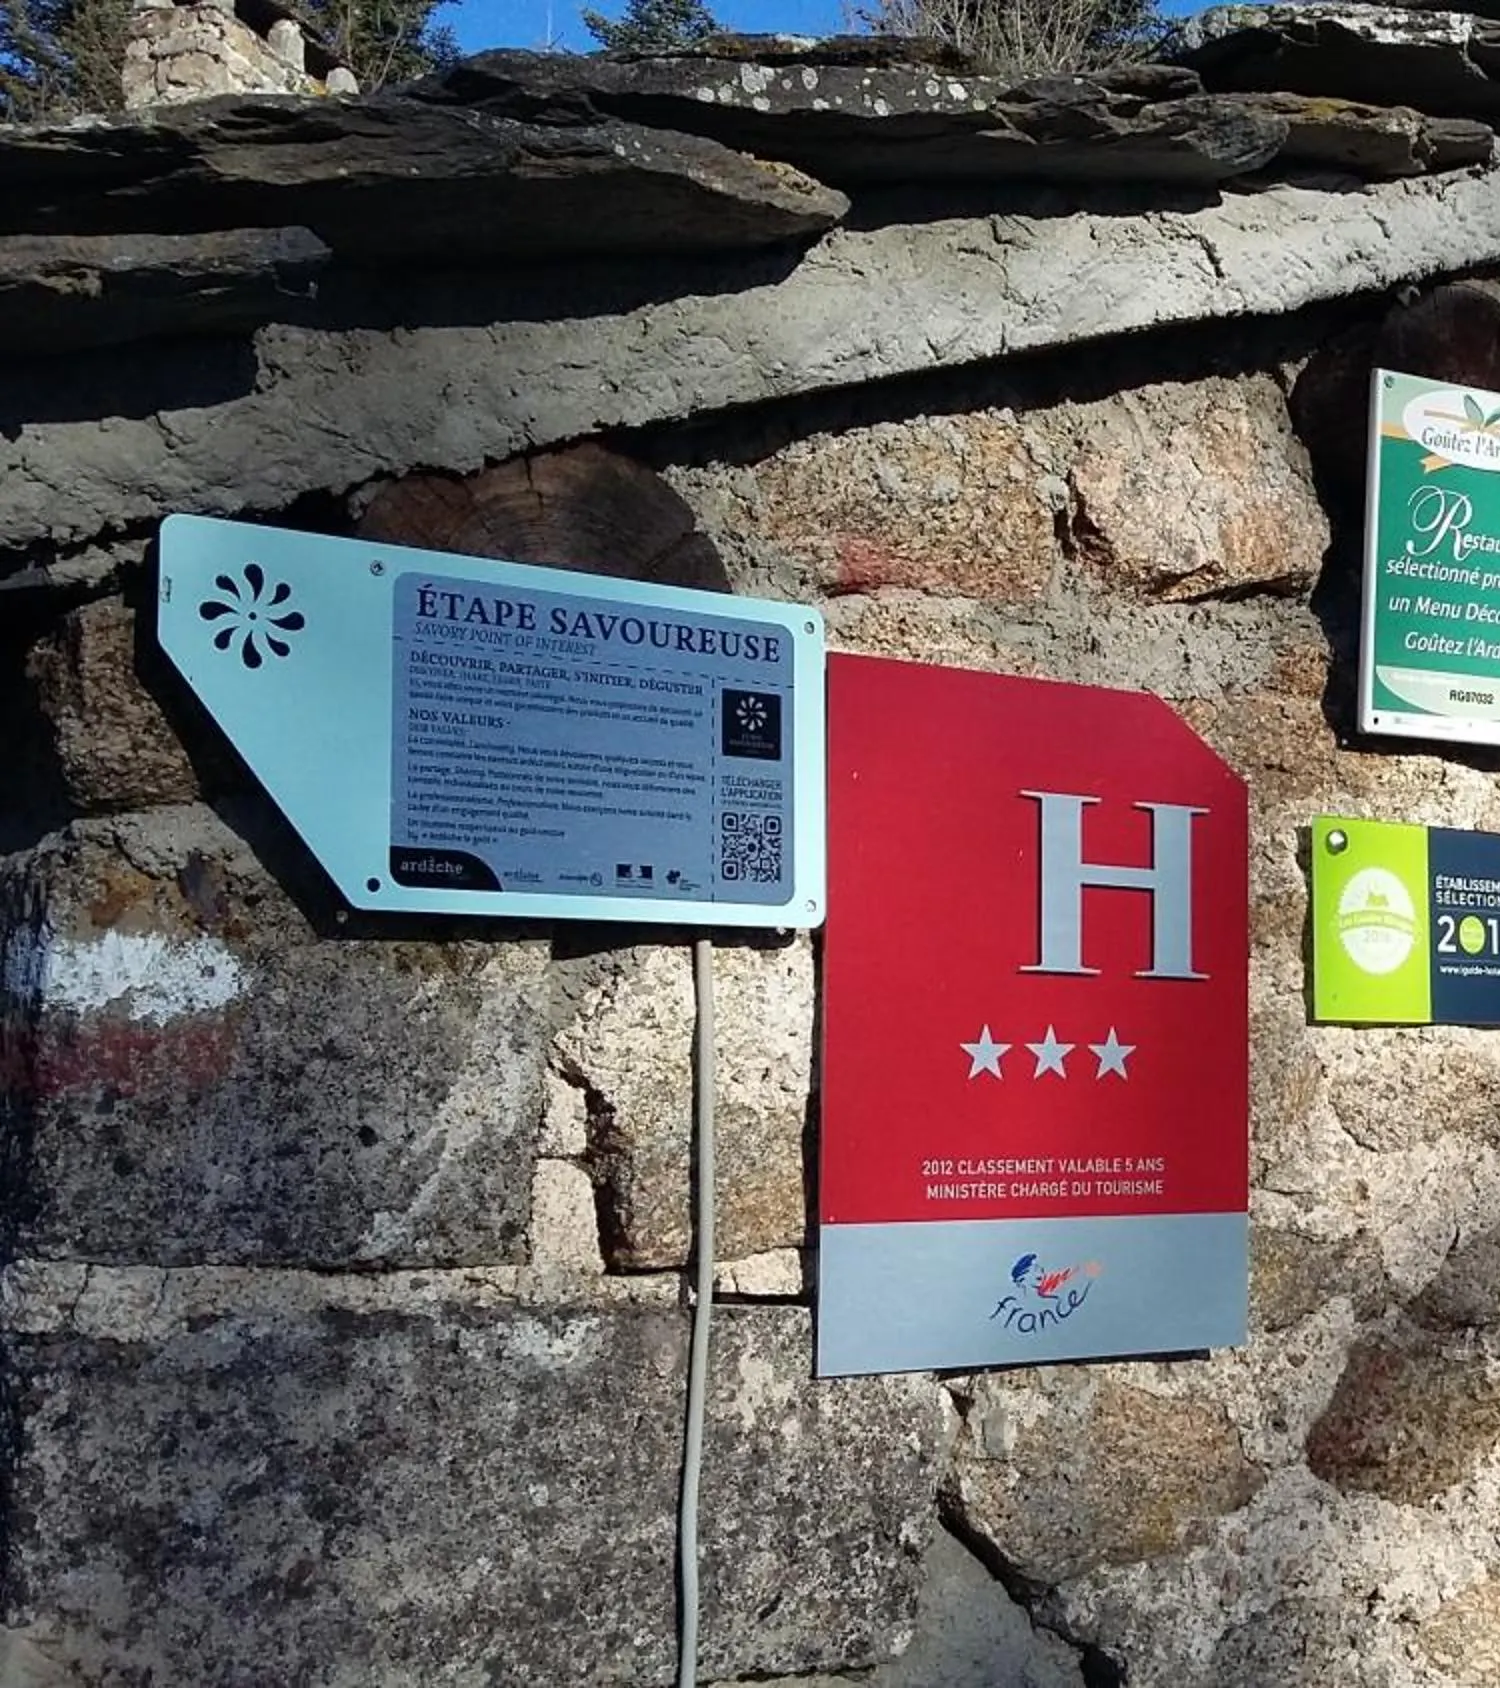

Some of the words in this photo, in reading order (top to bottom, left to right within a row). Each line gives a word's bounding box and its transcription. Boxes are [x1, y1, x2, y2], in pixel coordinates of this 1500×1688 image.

[1421, 426, 1470, 454] Goûtez
[1386, 556, 1480, 585] sélectionné
[1389, 596, 1410, 613] un
[1414, 596, 1461, 619] Menu
[416, 583, 537, 631] ÉTAPE
[550, 607, 780, 663] SAVOUREUSE
[415, 622, 470, 641] SAVORY
[471, 629, 512, 647] POINT
[515, 634, 533, 648] OF
[535, 637, 595, 657] INTEREST
[1405, 631, 1464, 656] Goûtez
[639, 677, 704, 696] DÉGUSTER
[409, 707, 438, 721] NOS
[1019, 789, 1210, 980] H
[922, 1159, 953, 1176] 2012
[957, 1159, 1053, 1176] CLASSEMENT
[1057, 1157, 1121, 1173] VALABLE
[1124, 1157, 1132, 1172] 5
[1137, 1157, 1165, 1172] ANS
[927, 1180, 1006, 1199] MINISTÈRE
[1010, 1180, 1067, 1197] CHARGÉ
[1071, 1181, 1092, 1195] DU
[1095, 1179, 1164, 1195] TOURISME
